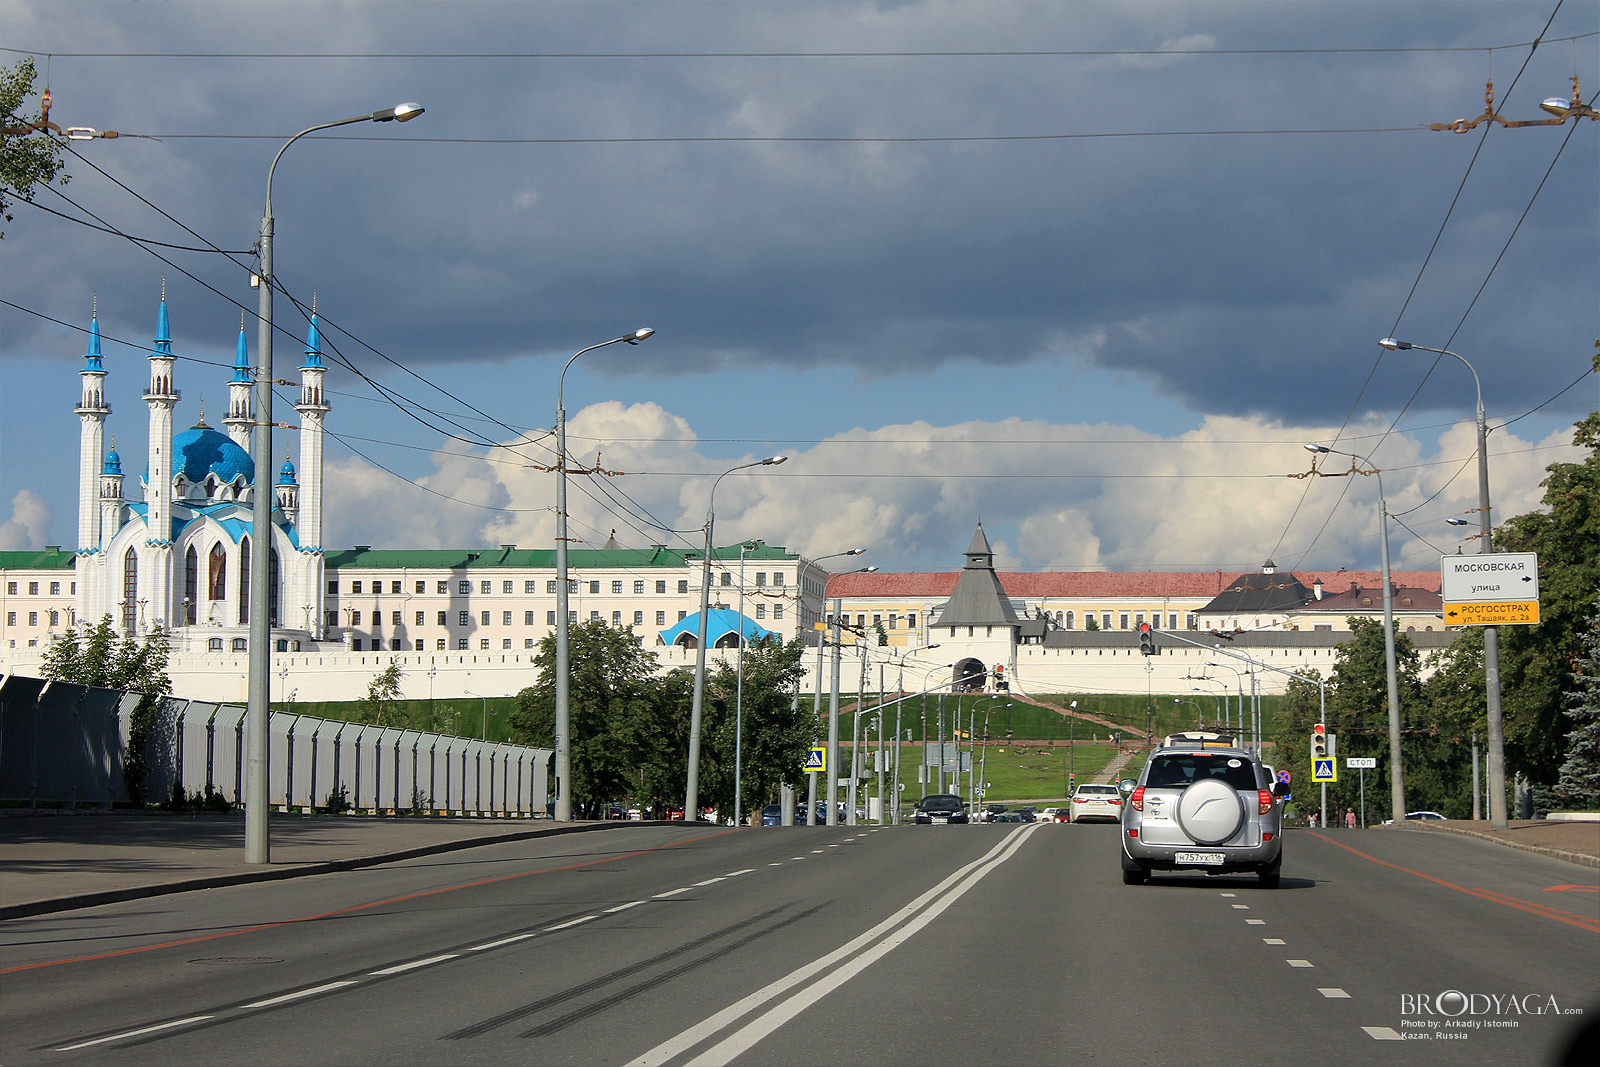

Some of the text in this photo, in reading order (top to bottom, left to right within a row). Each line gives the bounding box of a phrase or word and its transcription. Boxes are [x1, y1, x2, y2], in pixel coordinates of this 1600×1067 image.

[1454, 562, 1525, 573] МОСКОВСКАЯ
[1471, 584, 1501, 593] улица
[1461, 604, 1530, 614] РОСГОССТРАХ
